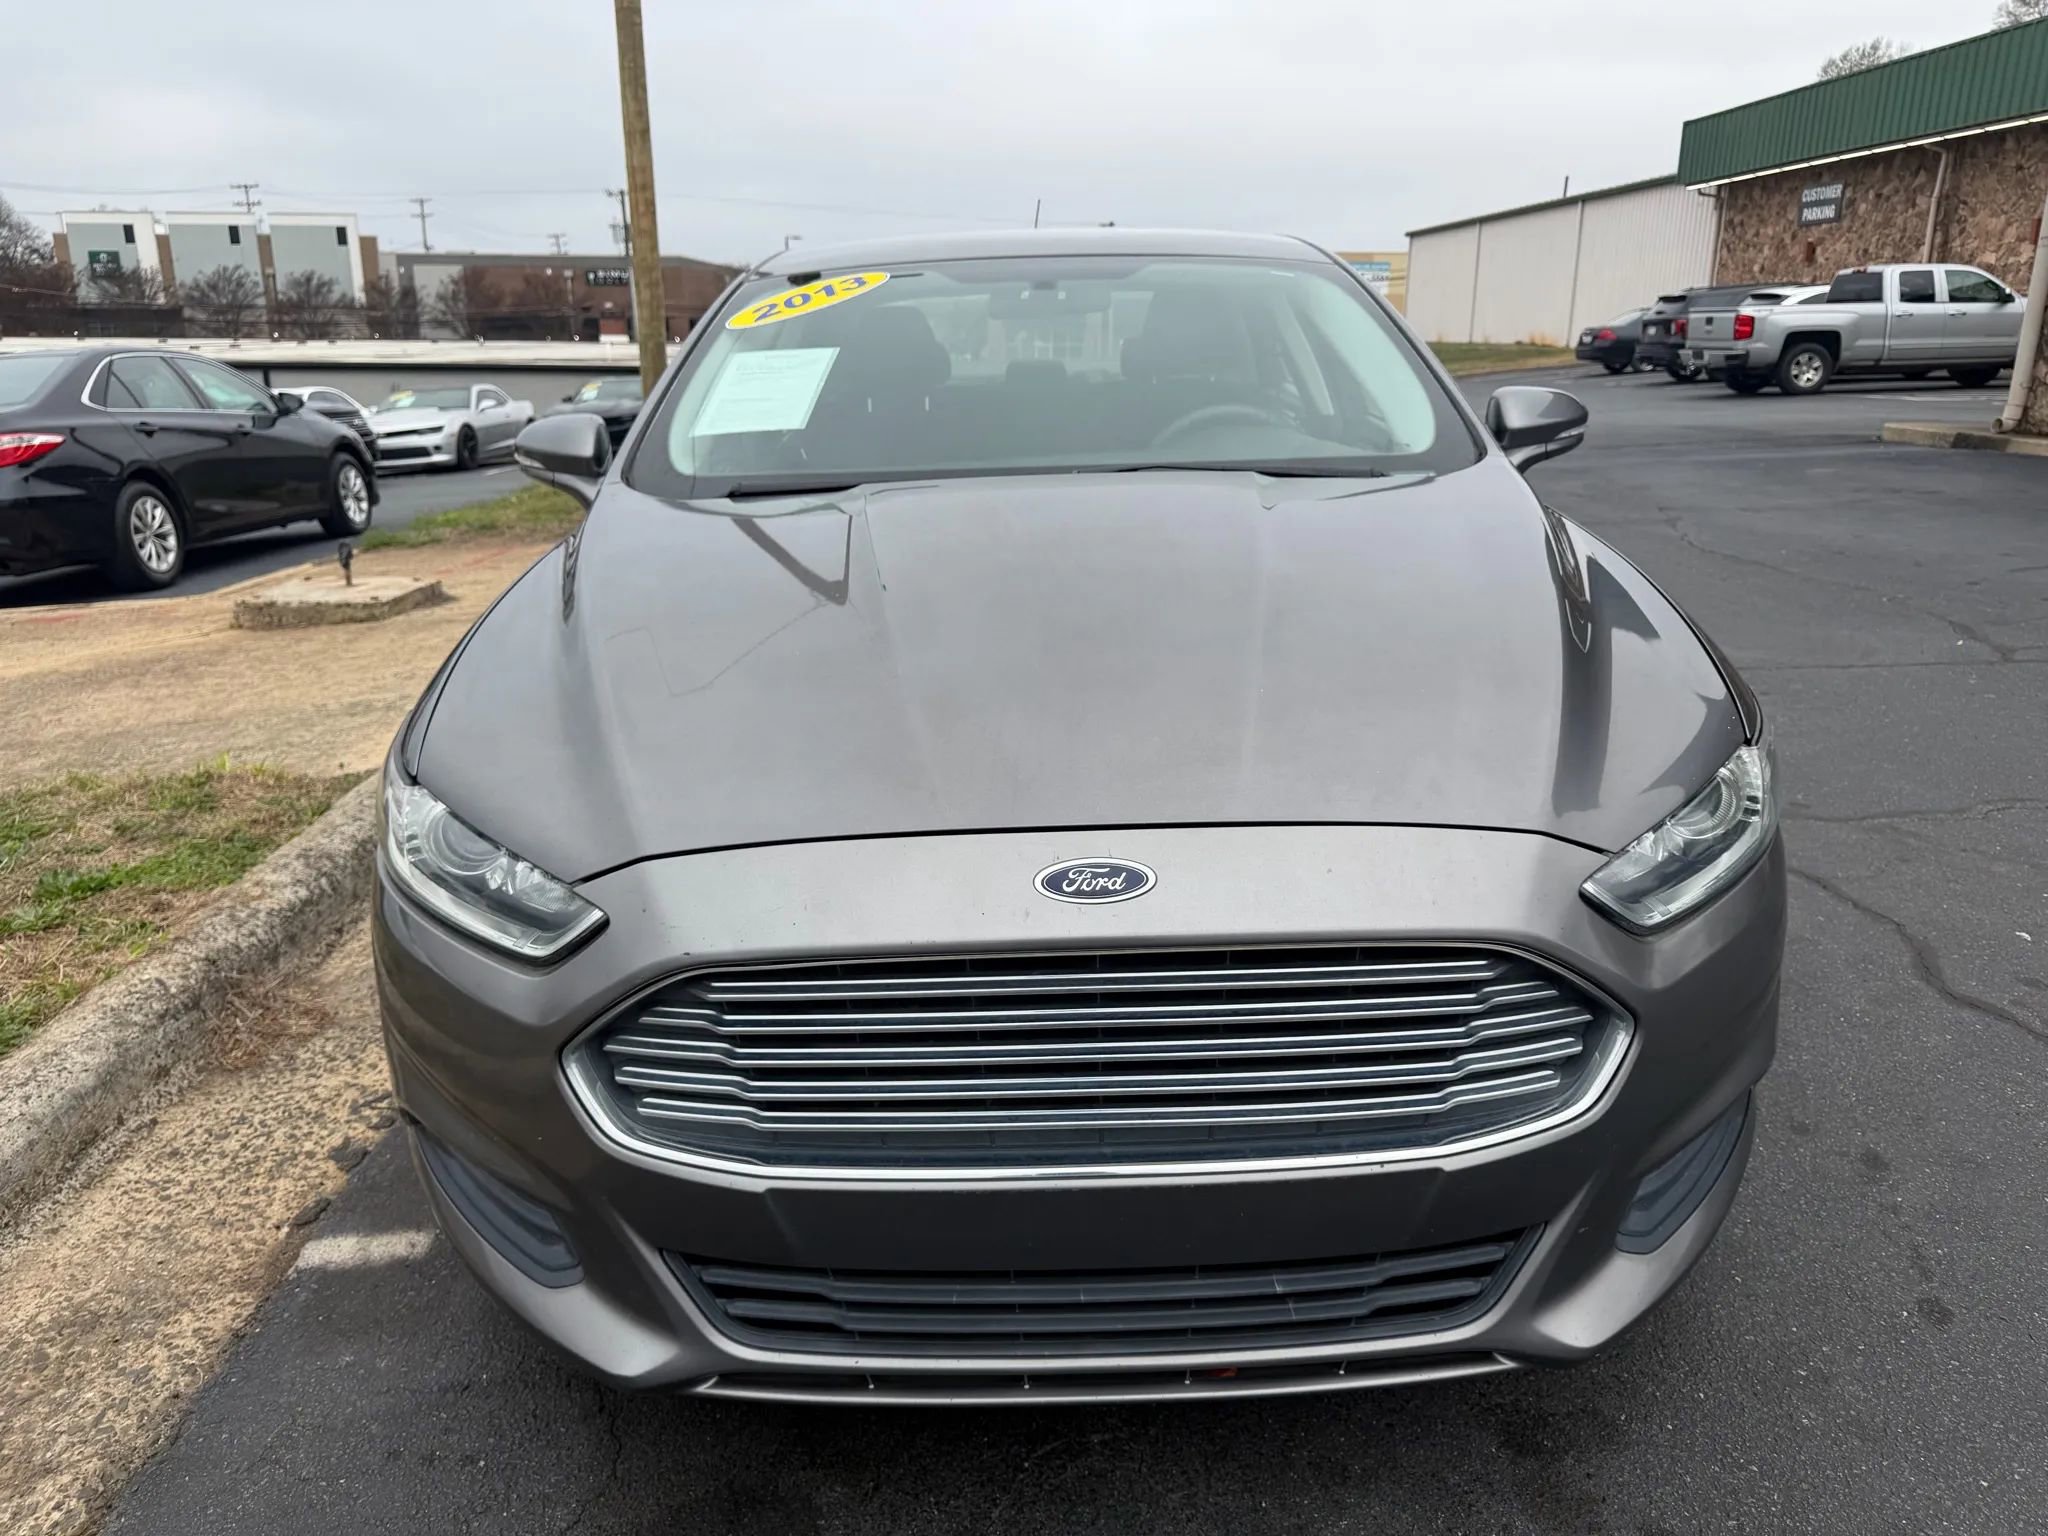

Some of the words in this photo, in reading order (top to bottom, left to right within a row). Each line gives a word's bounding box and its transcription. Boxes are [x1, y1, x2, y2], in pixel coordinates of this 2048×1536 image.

[1802, 184, 1843, 202] CUSTOMER
[1802, 204, 1836, 221] PARKING
[752, 277, 867, 322] 2013
[1062, 867, 1127, 892] Ford
